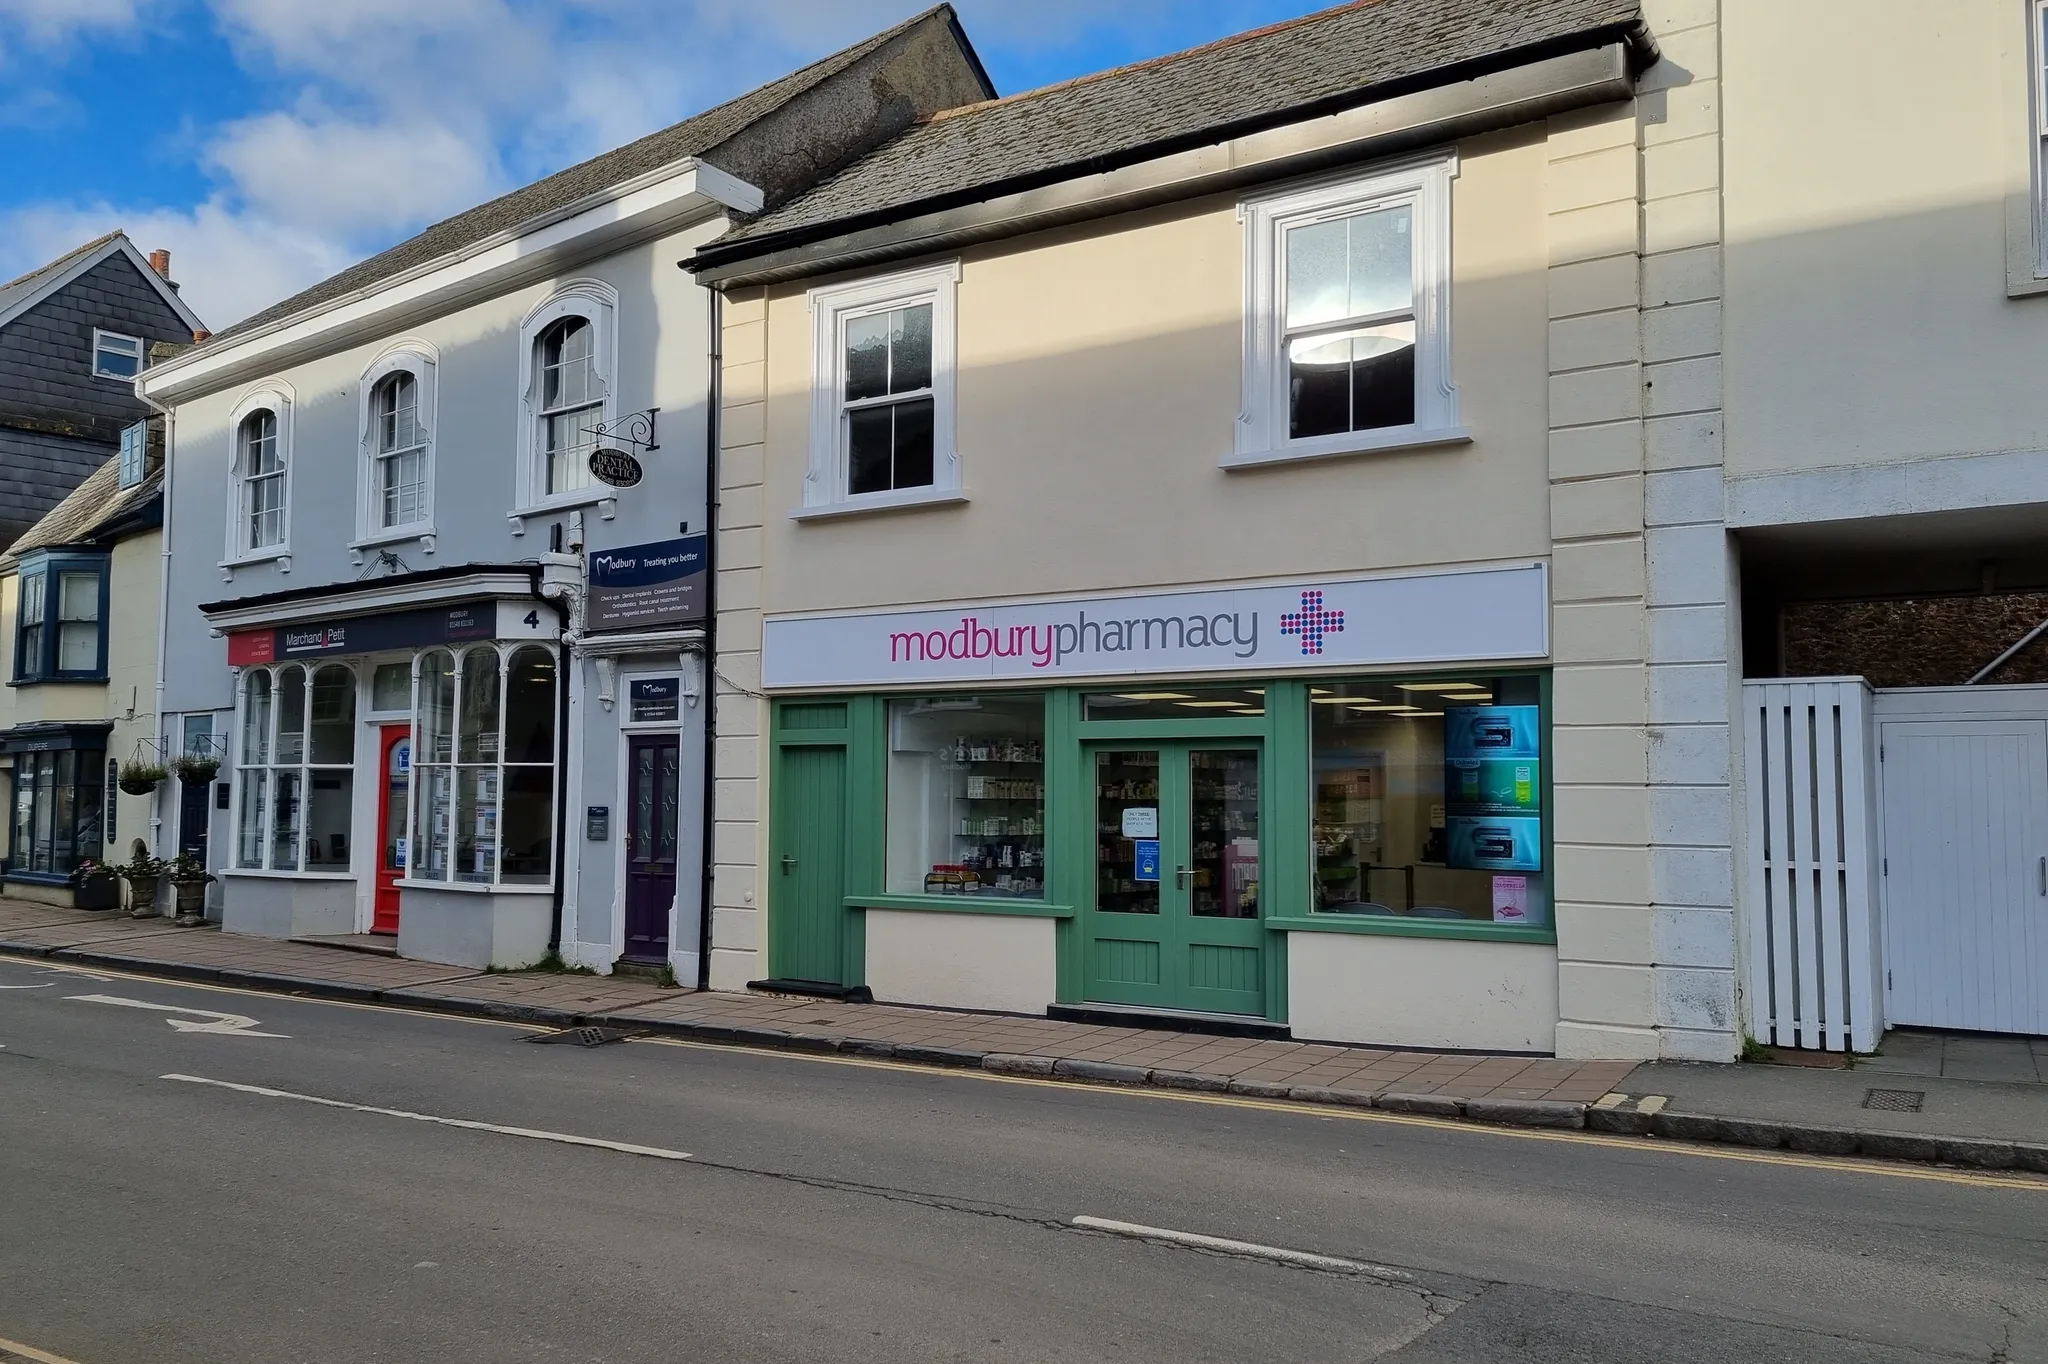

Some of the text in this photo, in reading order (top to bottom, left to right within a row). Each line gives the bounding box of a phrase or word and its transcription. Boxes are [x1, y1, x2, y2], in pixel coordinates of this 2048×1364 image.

[597, 454, 635, 471] DENTAL
[601, 450, 631, 462] MODBURY
[592, 462, 639, 480] PRACTICE
[596, 553, 698, 576] Modbury Treating you better
[635, 590, 652, 598] implants
[523, 609, 540, 629] 4
[286, 627, 345, 646] Marchand Petit
[425, 871, 439, 880] SALES
